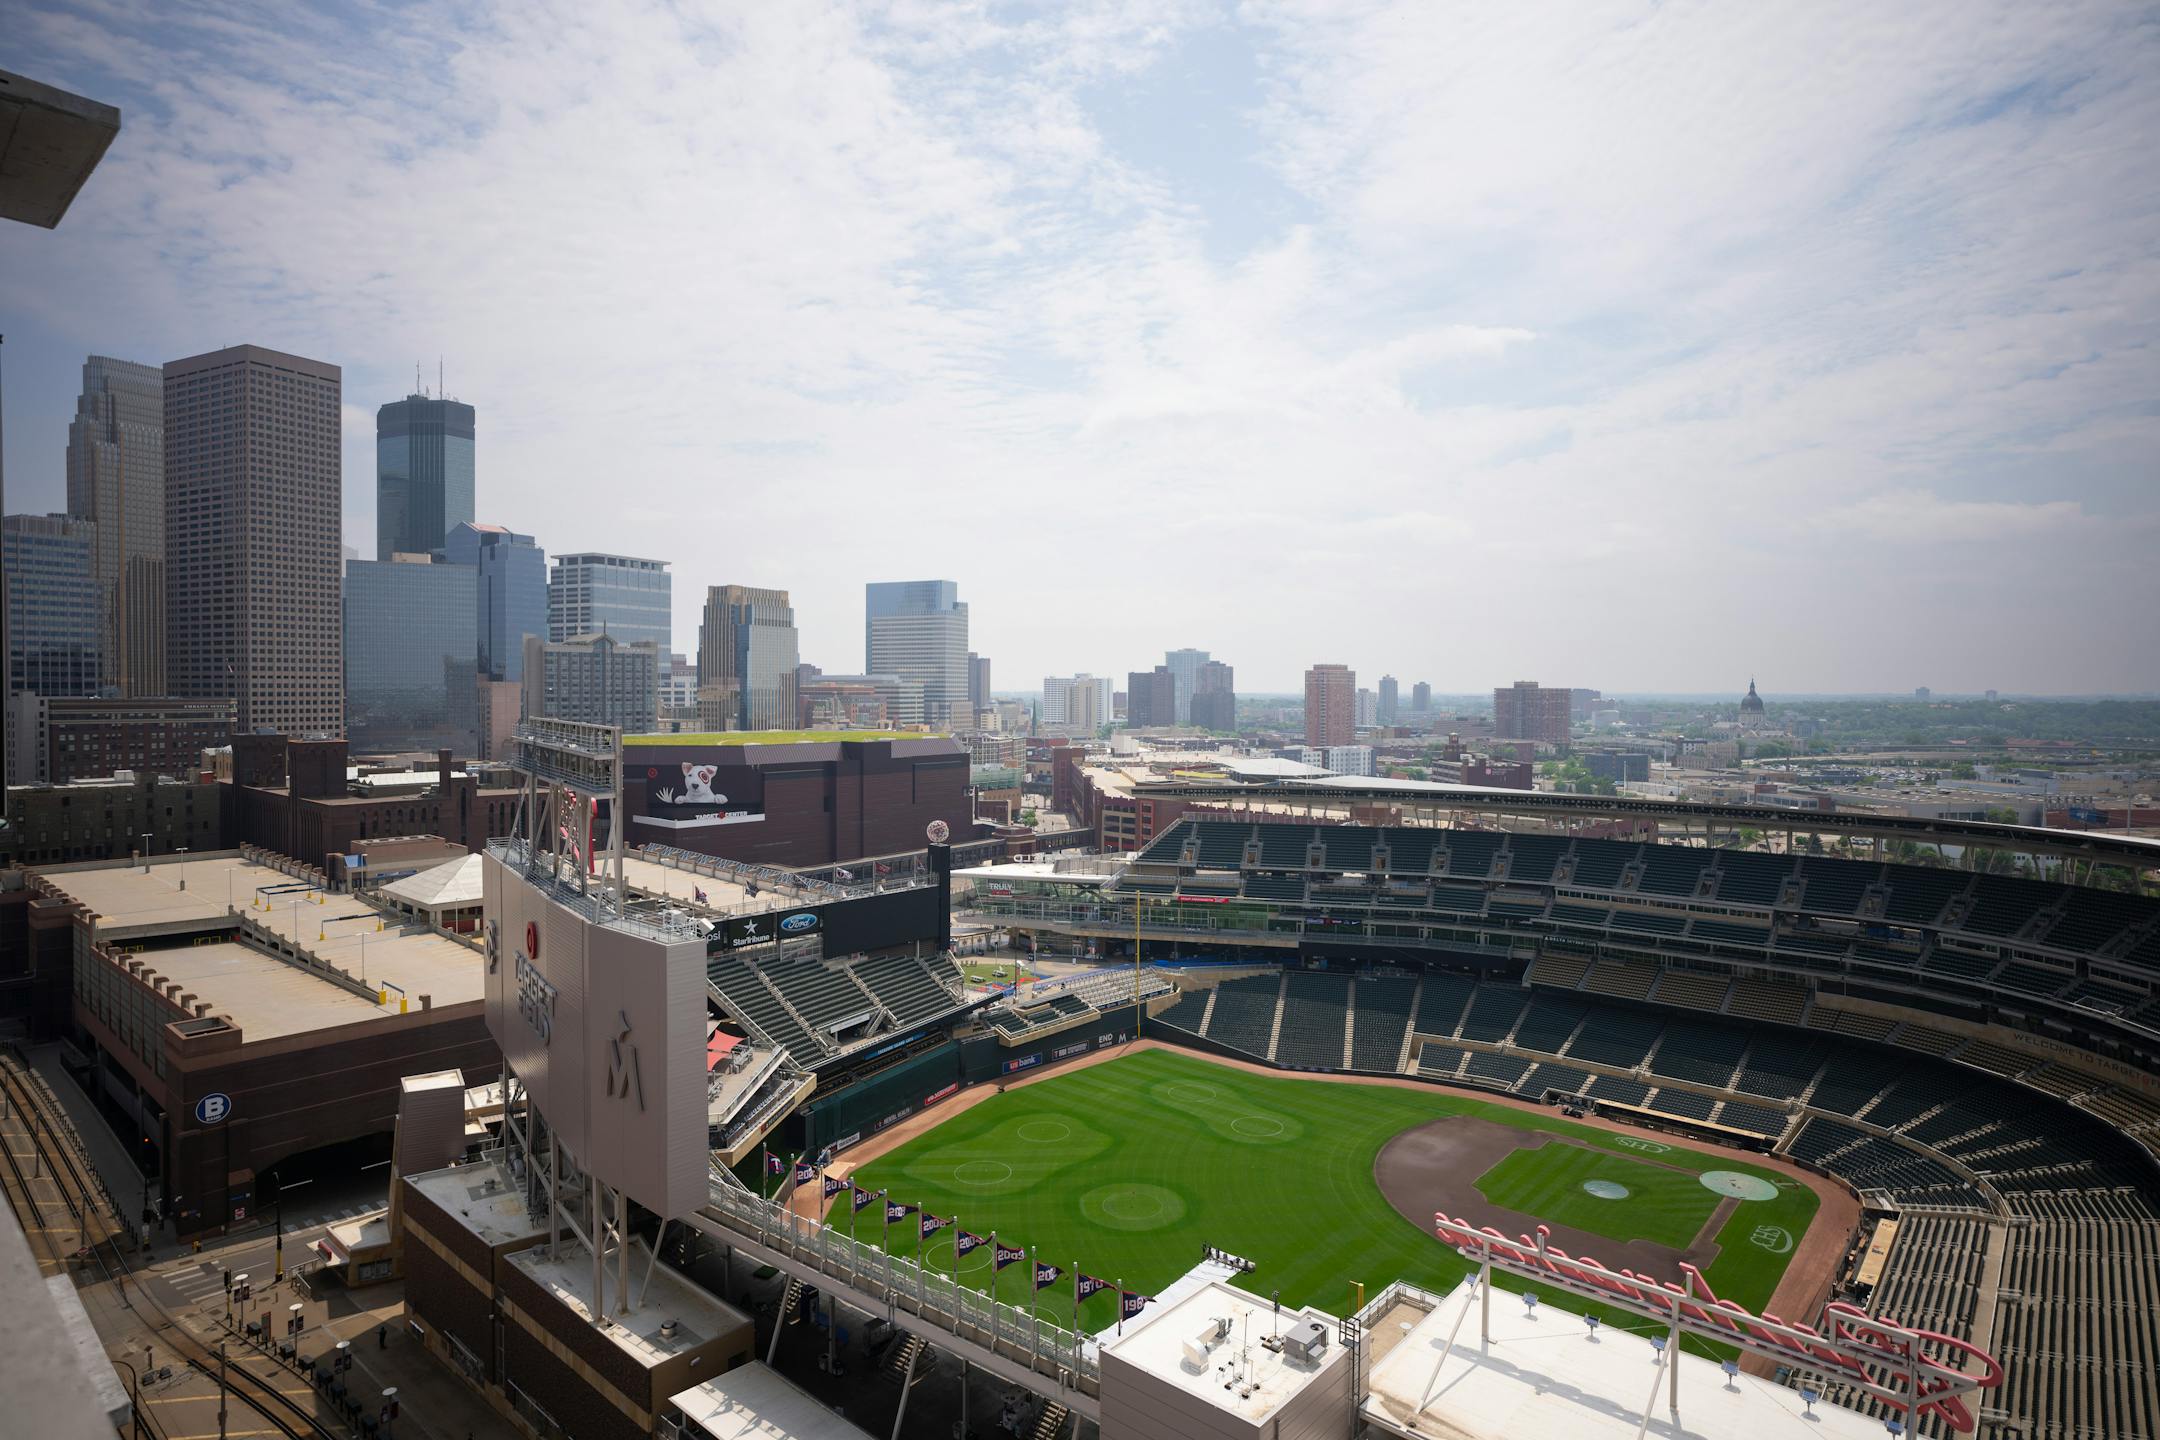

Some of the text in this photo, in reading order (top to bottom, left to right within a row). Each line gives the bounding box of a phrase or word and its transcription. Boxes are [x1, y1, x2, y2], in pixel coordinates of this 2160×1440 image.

[2013, 1032, 2075, 1057] WELCOME
[2079, 1053, 2094, 1063] TO
[205, 1097, 224, 1117] B
